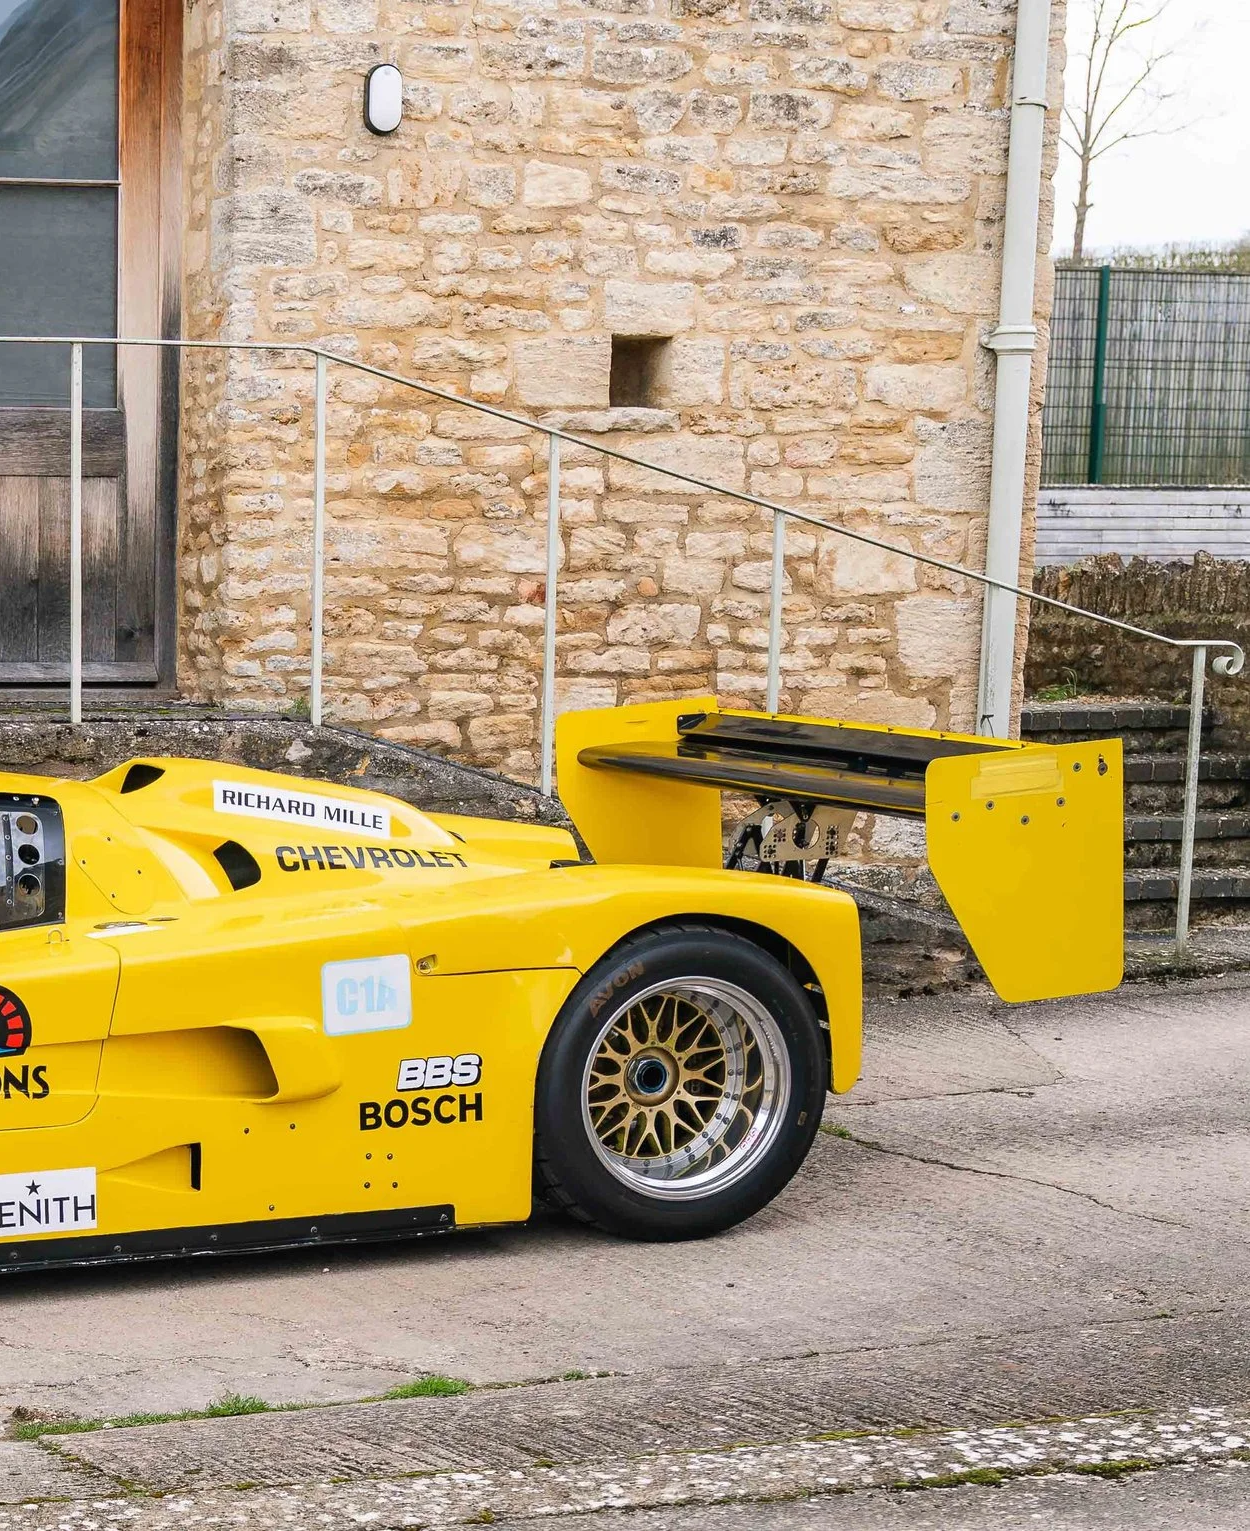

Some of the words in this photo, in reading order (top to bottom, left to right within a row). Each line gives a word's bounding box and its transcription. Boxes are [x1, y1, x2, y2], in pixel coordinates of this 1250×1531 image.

[222, 789, 315, 818] RICHARD
[324, 805, 383, 830] MILLE
[275, 845, 469, 872] CHEVROLET
[590, 960, 646, 1018] AVON
[395, 1053, 483, 1092] BBS
[359, 1092, 483, 1131] BOSCH
